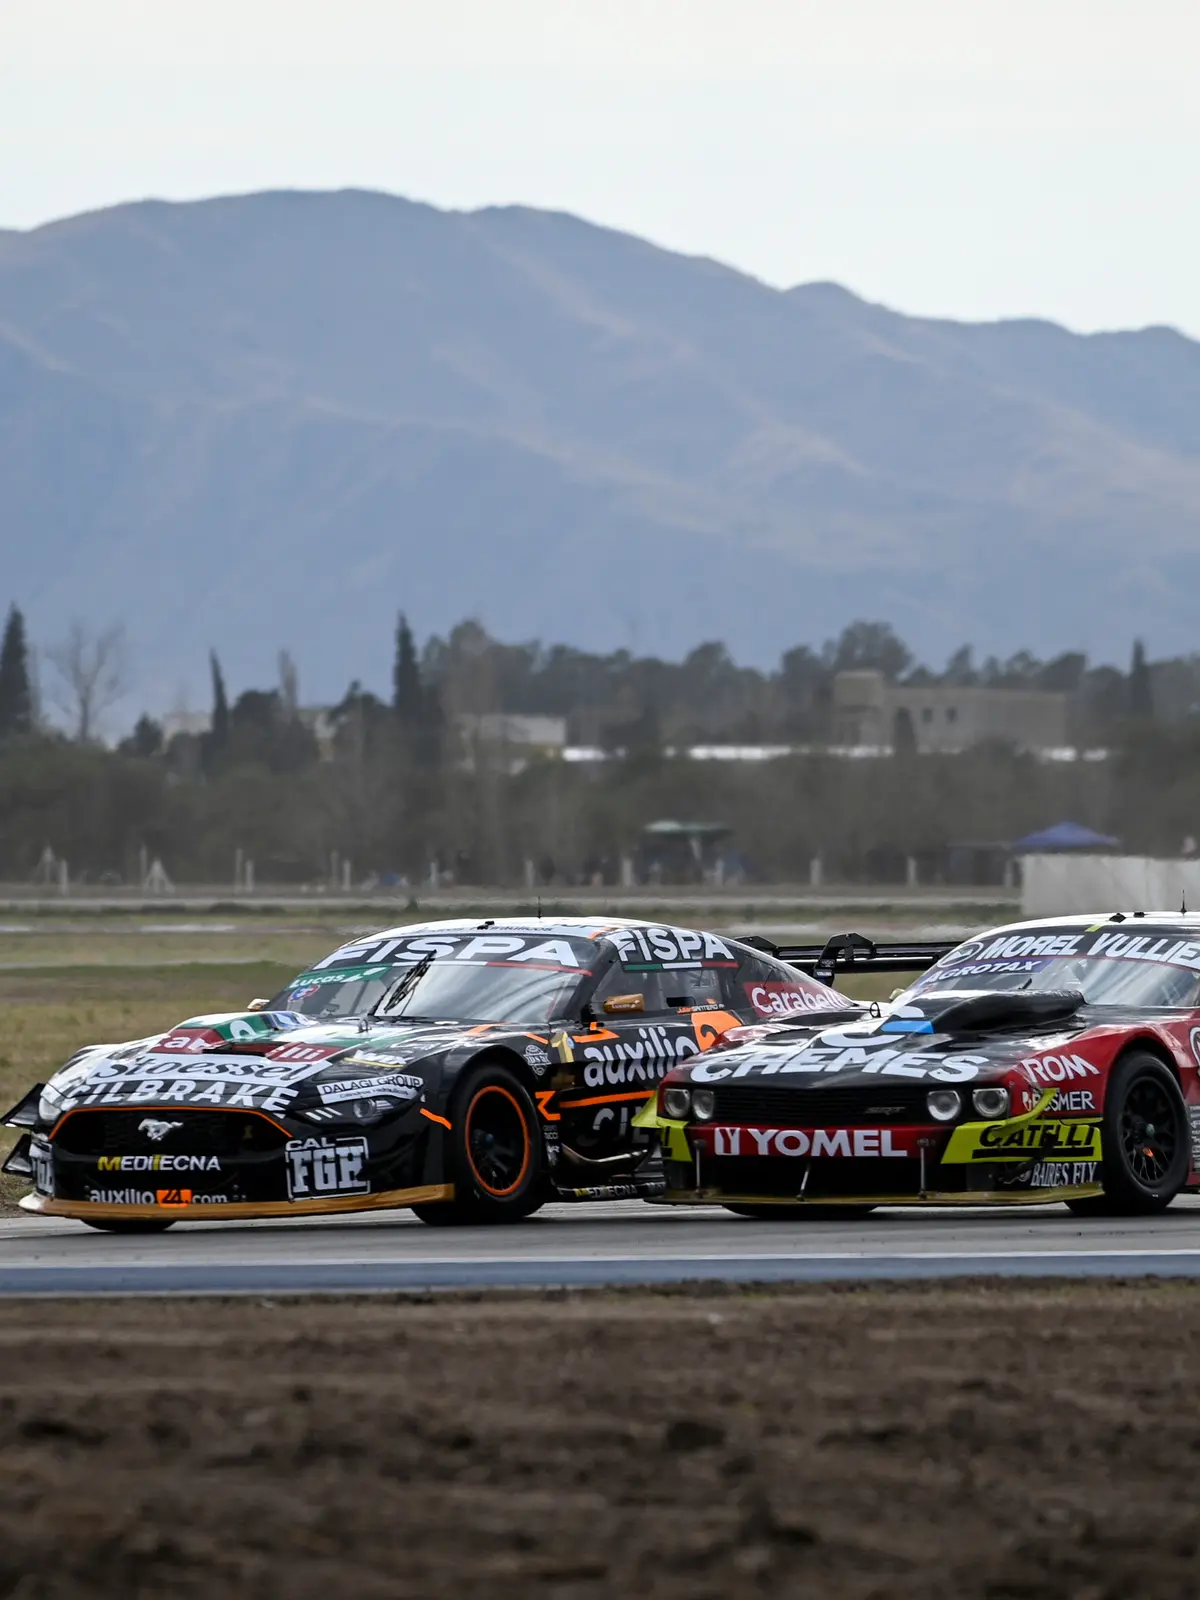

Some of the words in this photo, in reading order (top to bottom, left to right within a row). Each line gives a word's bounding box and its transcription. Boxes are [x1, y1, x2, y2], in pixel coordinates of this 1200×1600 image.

[312, 936, 580, 970] FISPA
[604, 928, 735, 962] FISPA
[977, 934, 1087, 961] MOREL
[289, 973, 346, 989] Lucas
[921, 960, 1043, 986] AGROTAX
[690, 1047, 990, 1083] CHEMES
[377, 1075, 421, 1089] GROUP
[61, 1080, 300, 1120] CILBRAKE
[285, 1137, 336, 1151] CAL
[746, 1129, 908, 1157] YOMEL
